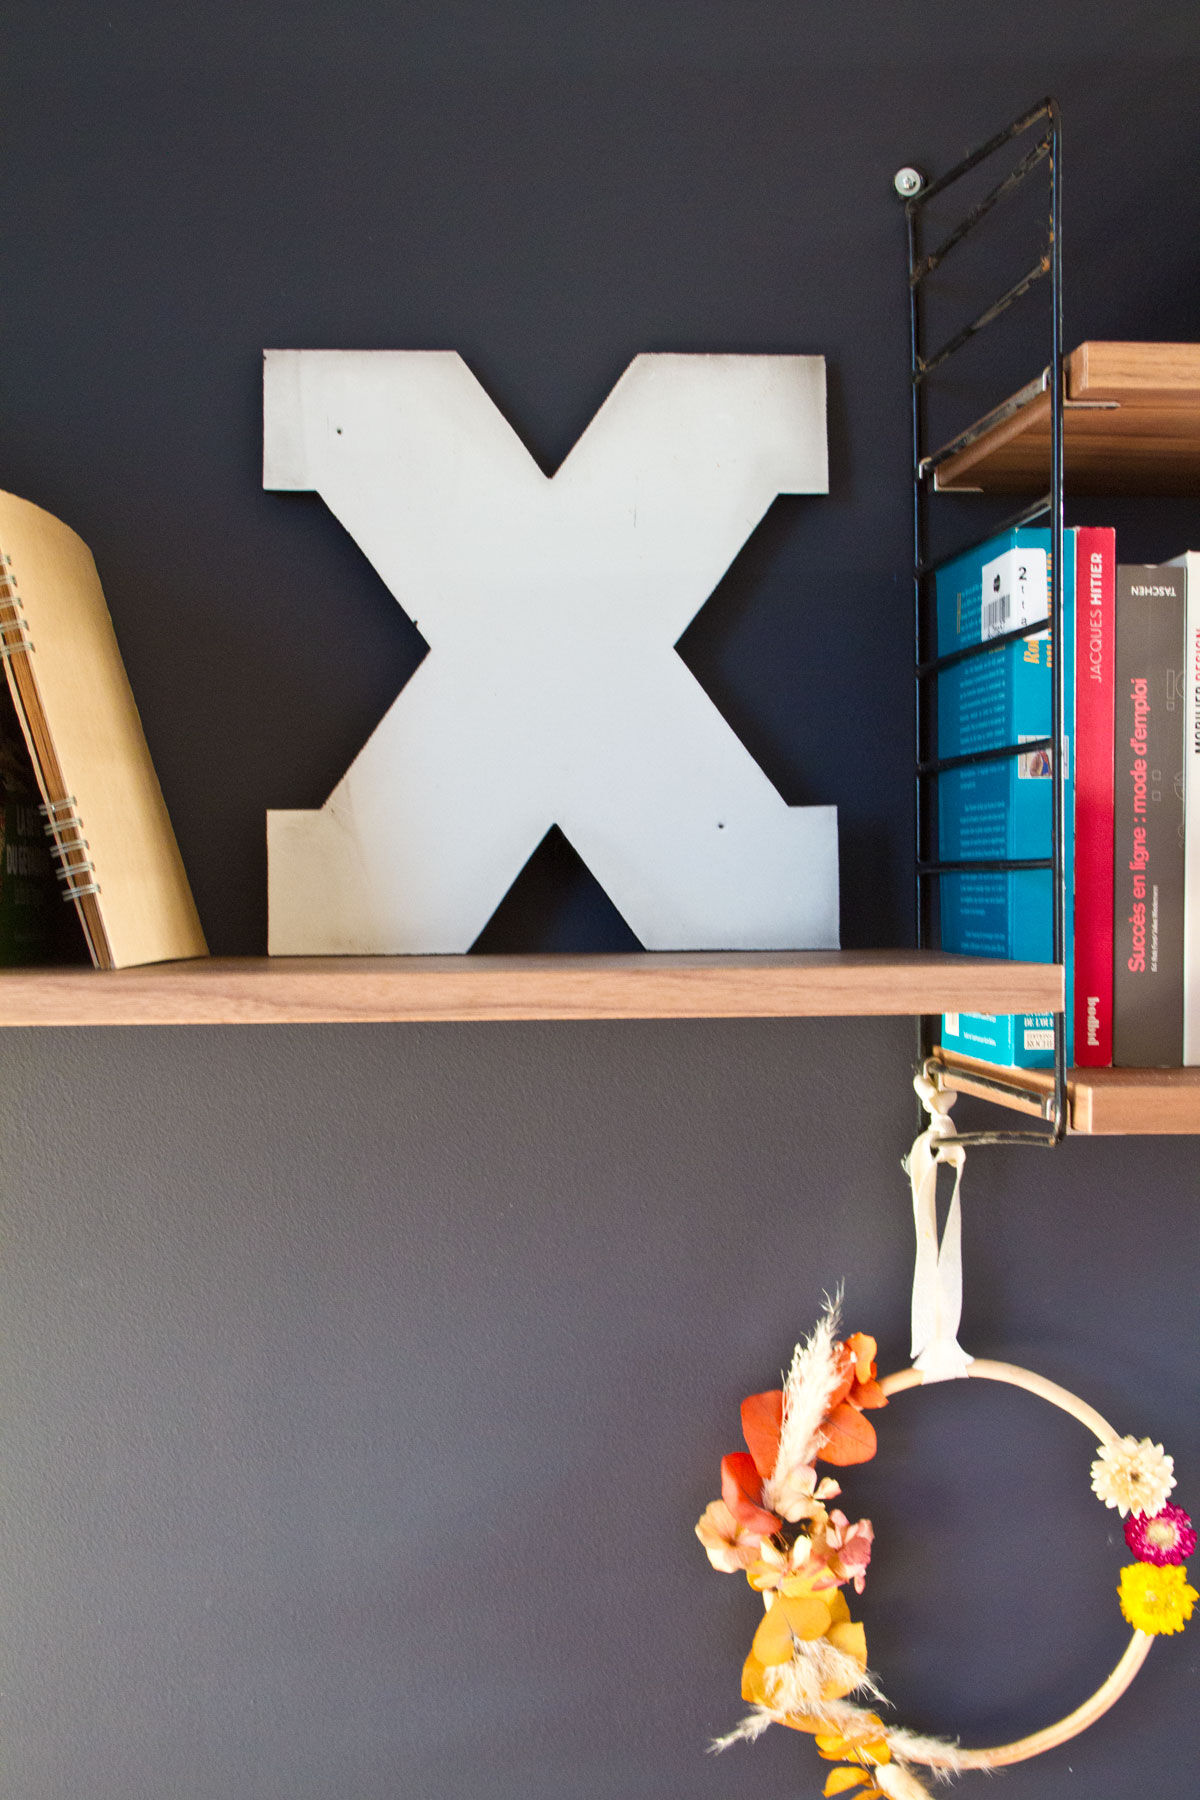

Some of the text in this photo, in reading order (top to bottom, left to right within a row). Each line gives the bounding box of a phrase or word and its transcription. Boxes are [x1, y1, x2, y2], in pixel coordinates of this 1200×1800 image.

[1018, 566, 1027, 581] 2
[1130, 585, 1177, 598] TASCHEN
[1089, 552, 1103, 683] JACQUES HITIER
[262, 348, 840, 956] X
[1129, 677, 1151, 756] d'emploi
[1129, 758, 1148, 814] mode
[1128, 826, 1151, 871] ligne
[1132, 874, 1147, 899] en
[1127, 902, 1147, 973] Succès
